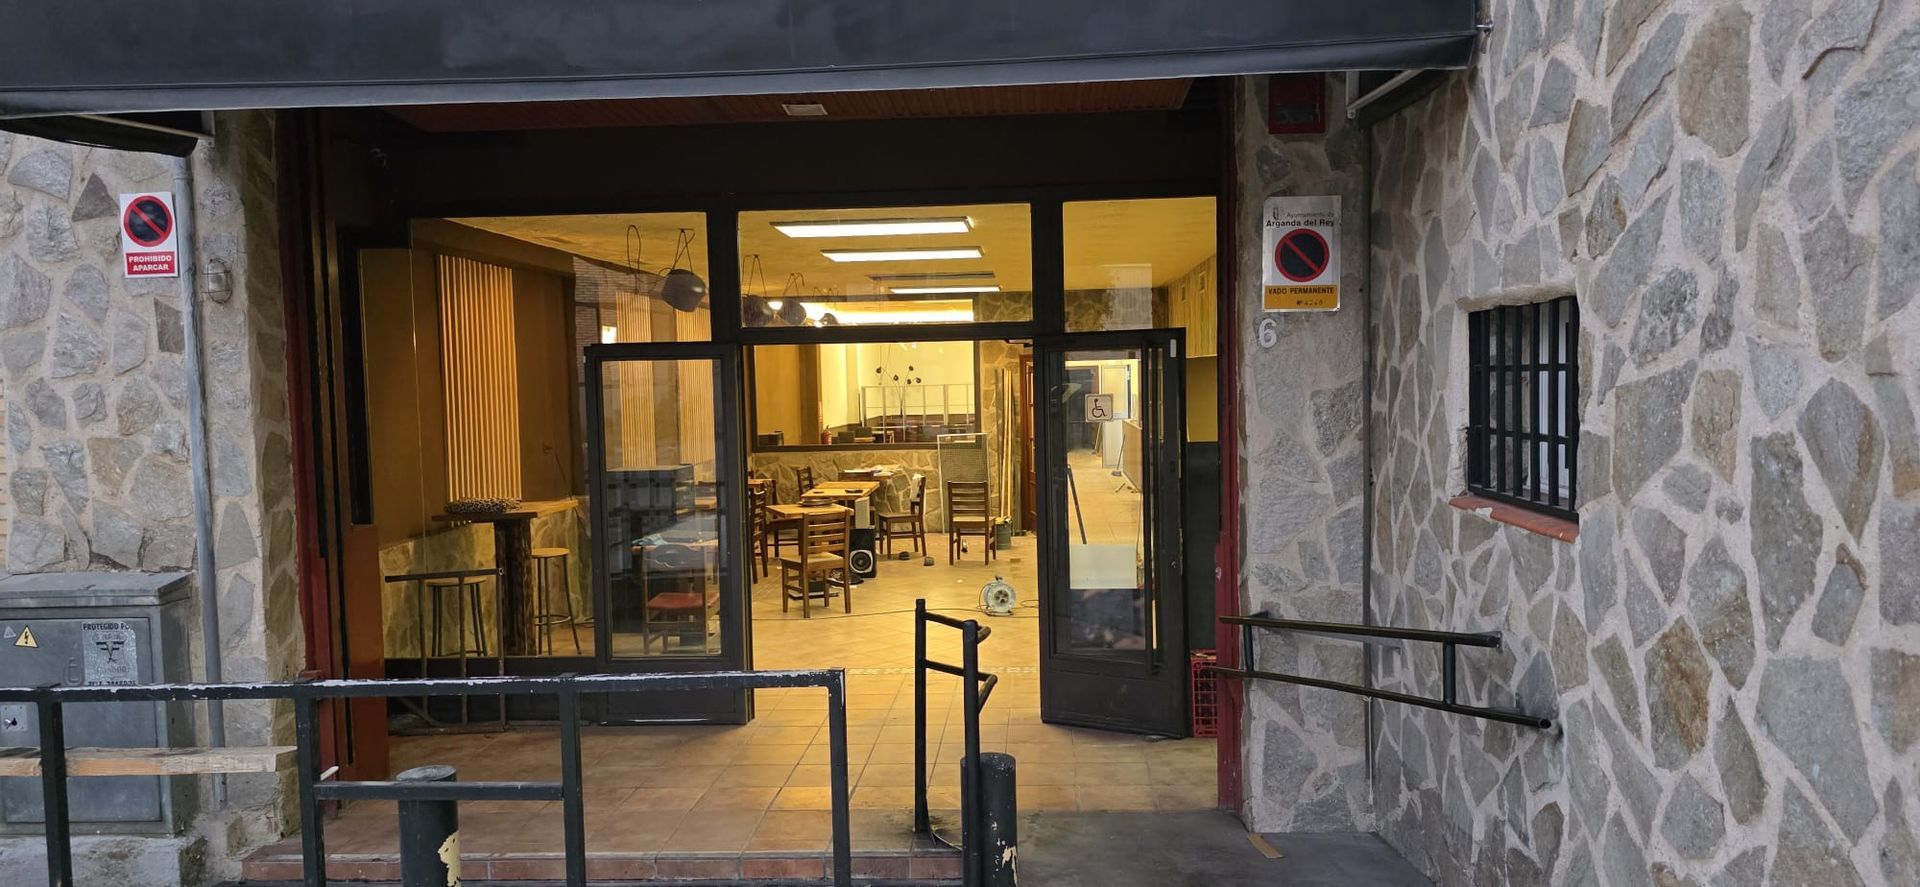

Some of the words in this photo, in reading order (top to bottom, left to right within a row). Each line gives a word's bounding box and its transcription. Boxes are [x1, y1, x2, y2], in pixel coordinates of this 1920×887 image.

[1266, 220, 1301, 229] Arganda
[1304, 219, 1317, 227] del
[1319, 218, 1335, 228] Rey
[128, 255, 172, 263] PROHIBIDO
[1268, 287, 1287, 295] VADO
[1290, 287, 1335, 295] PERMANENTE
[1259, 318, 1277, 348] 6
[82, 622, 119, 630] PROTEGIDO
